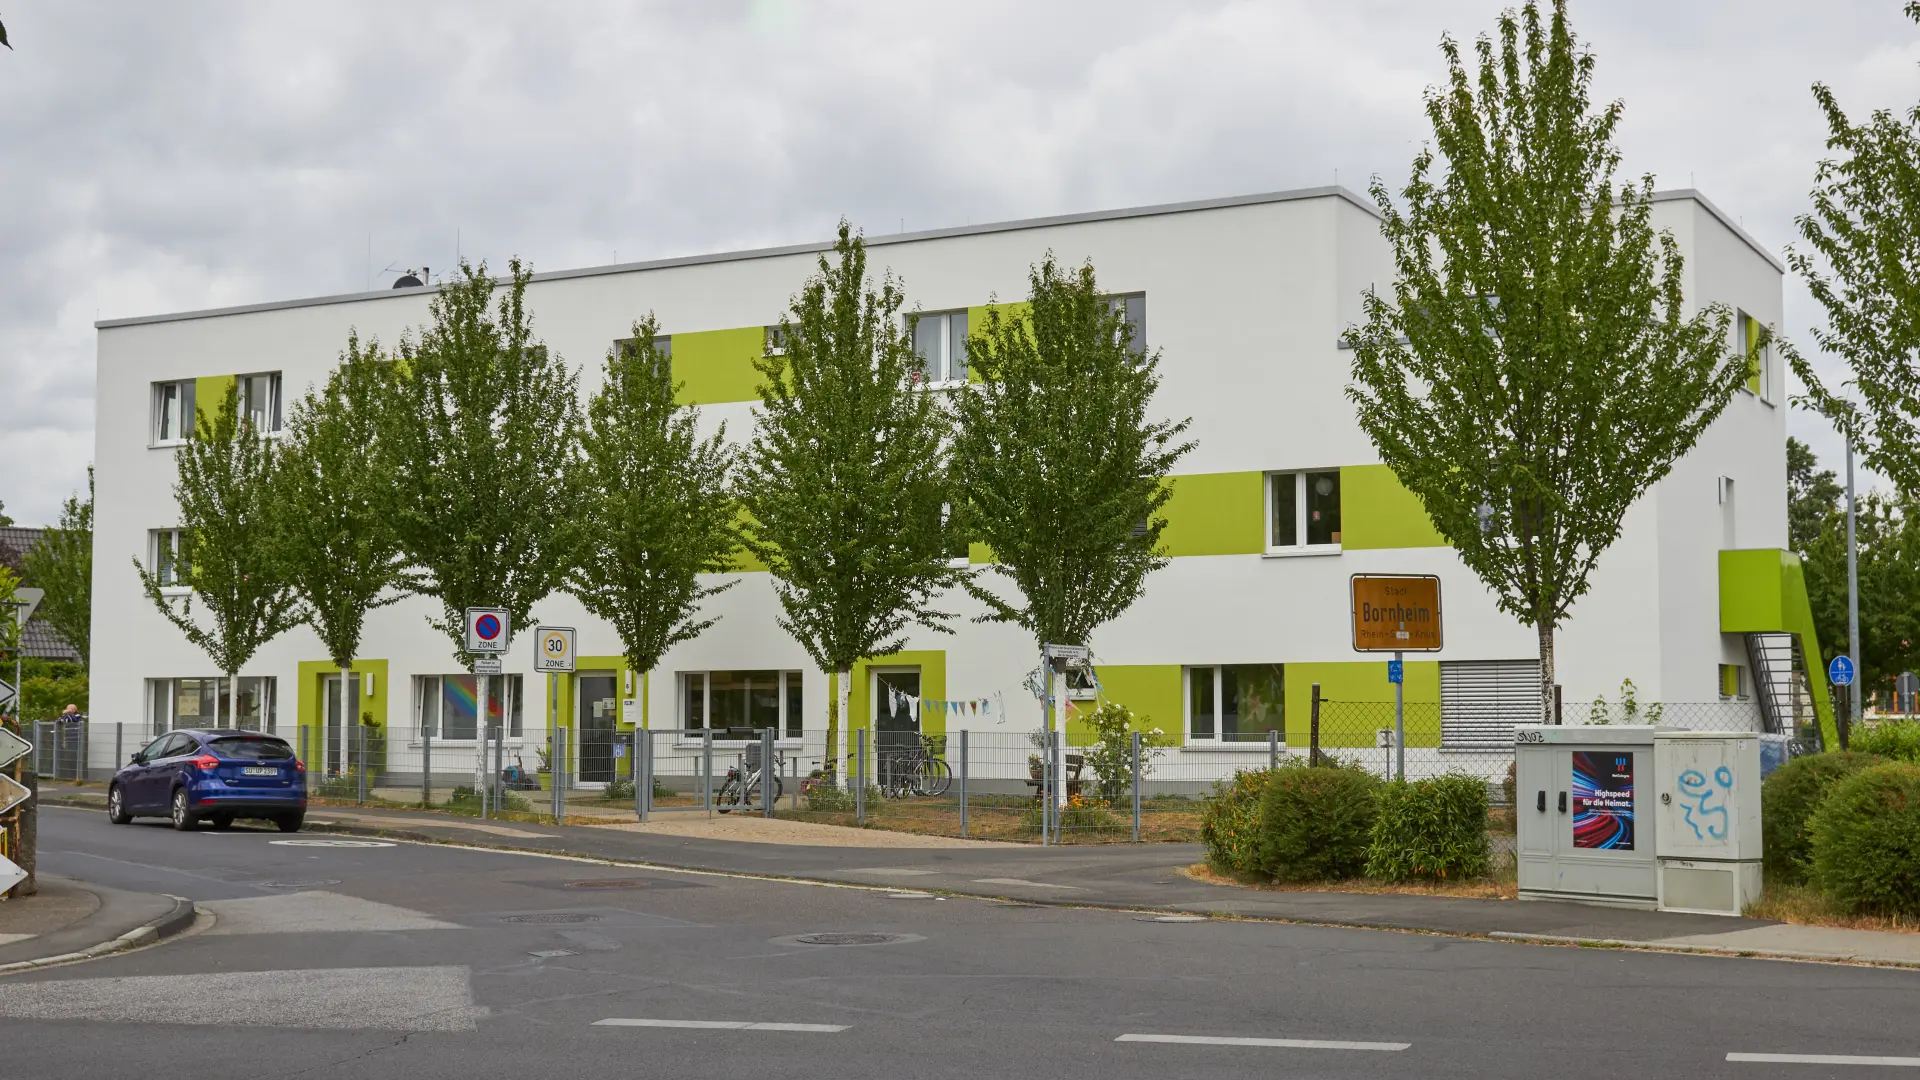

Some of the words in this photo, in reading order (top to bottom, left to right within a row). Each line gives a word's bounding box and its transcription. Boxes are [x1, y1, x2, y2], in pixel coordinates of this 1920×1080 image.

[1385, 586, 1406, 596] Stadt
[1363, 602, 1429, 622] Bornheim
[548, 639, 563, 652] 30
[545, 659, 565, 668] ZONE
[1594, 789, 1630, 798] Highspeed
[1582, 798, 1592, 806] für
[1593, 798, 1604, 806] die
[1605, 799, 1631, 807] Heimat.
